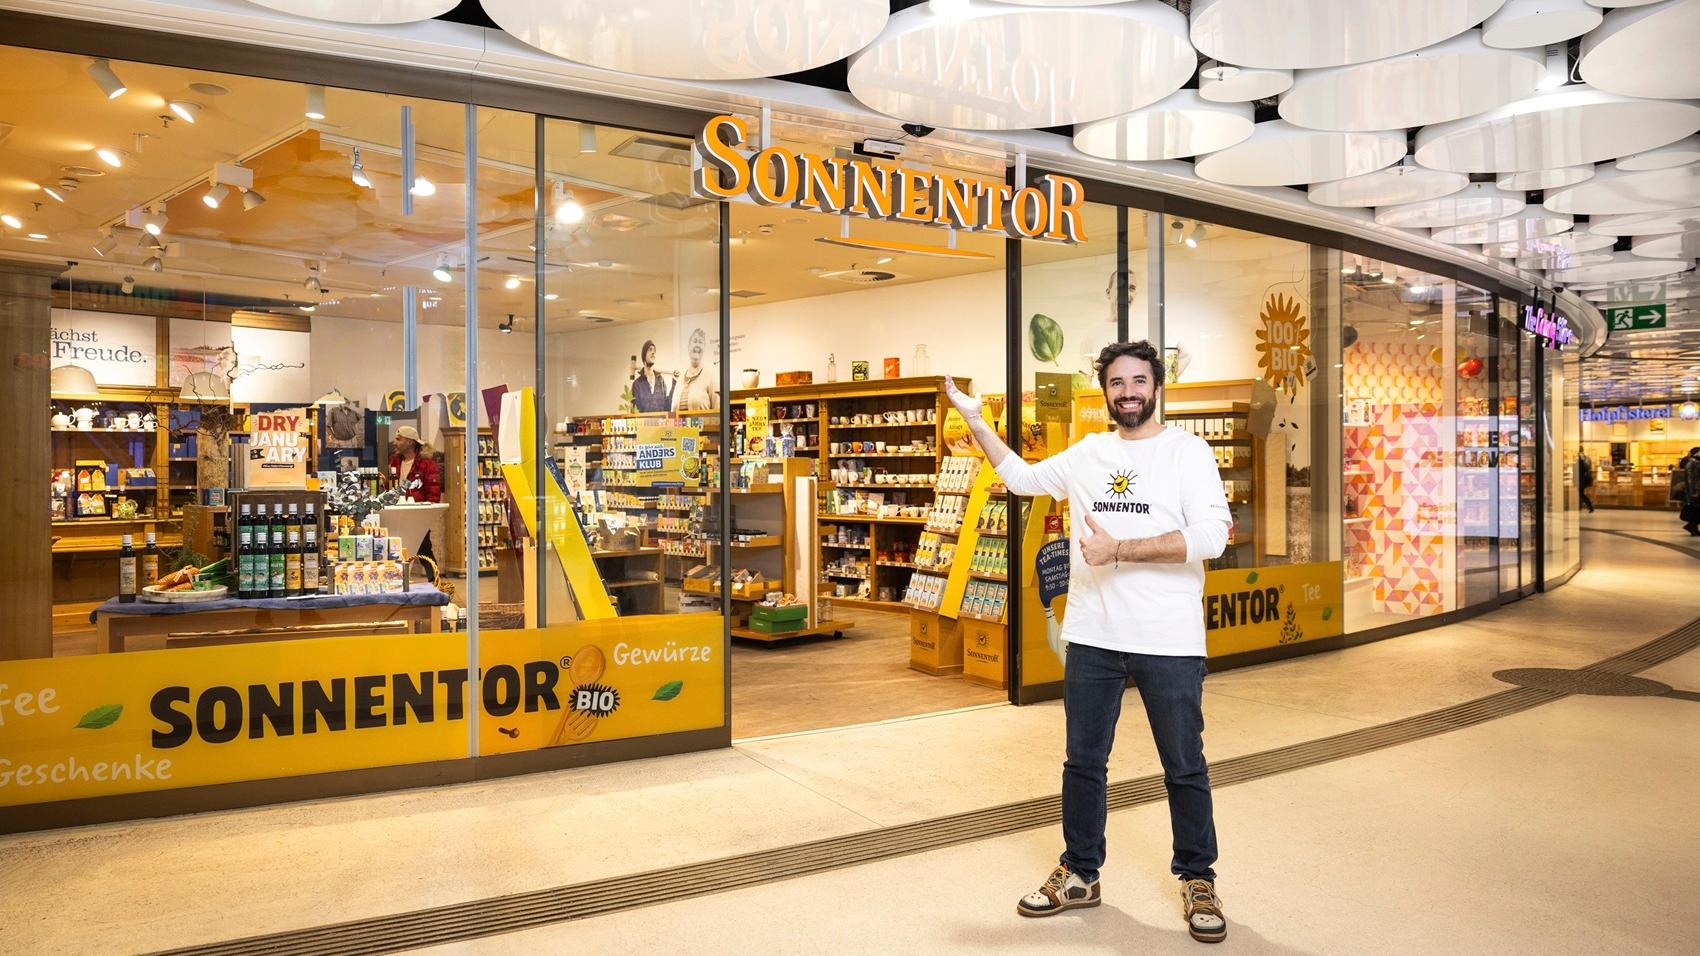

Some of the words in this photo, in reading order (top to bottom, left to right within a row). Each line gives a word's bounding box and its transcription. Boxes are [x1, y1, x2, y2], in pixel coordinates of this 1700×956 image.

[694, 114, 1089, 245] SONNENTOR
[52, 340, 147, 363] Freude.
[1271, 347, 1298, 372] BIO
[258, 415, 300, 432] DRY
[250, 431, 298, 447] JANU
[265, 446, 307, 463] ARY
[639, 460, 662, 469] KLUB
[1092, 501, 1150, 514] SONNENTOR
[1039, 549, 1069, 565] TEA-TIMES
[1042, 541, 1065, 555] UNSERE
[1301, 582, 1321, 603] Tee
[613, 641, 712, 666] Gewürze
[576, 690, 615, 712] BIO
[0, 753, 172, 787] Geschenke
